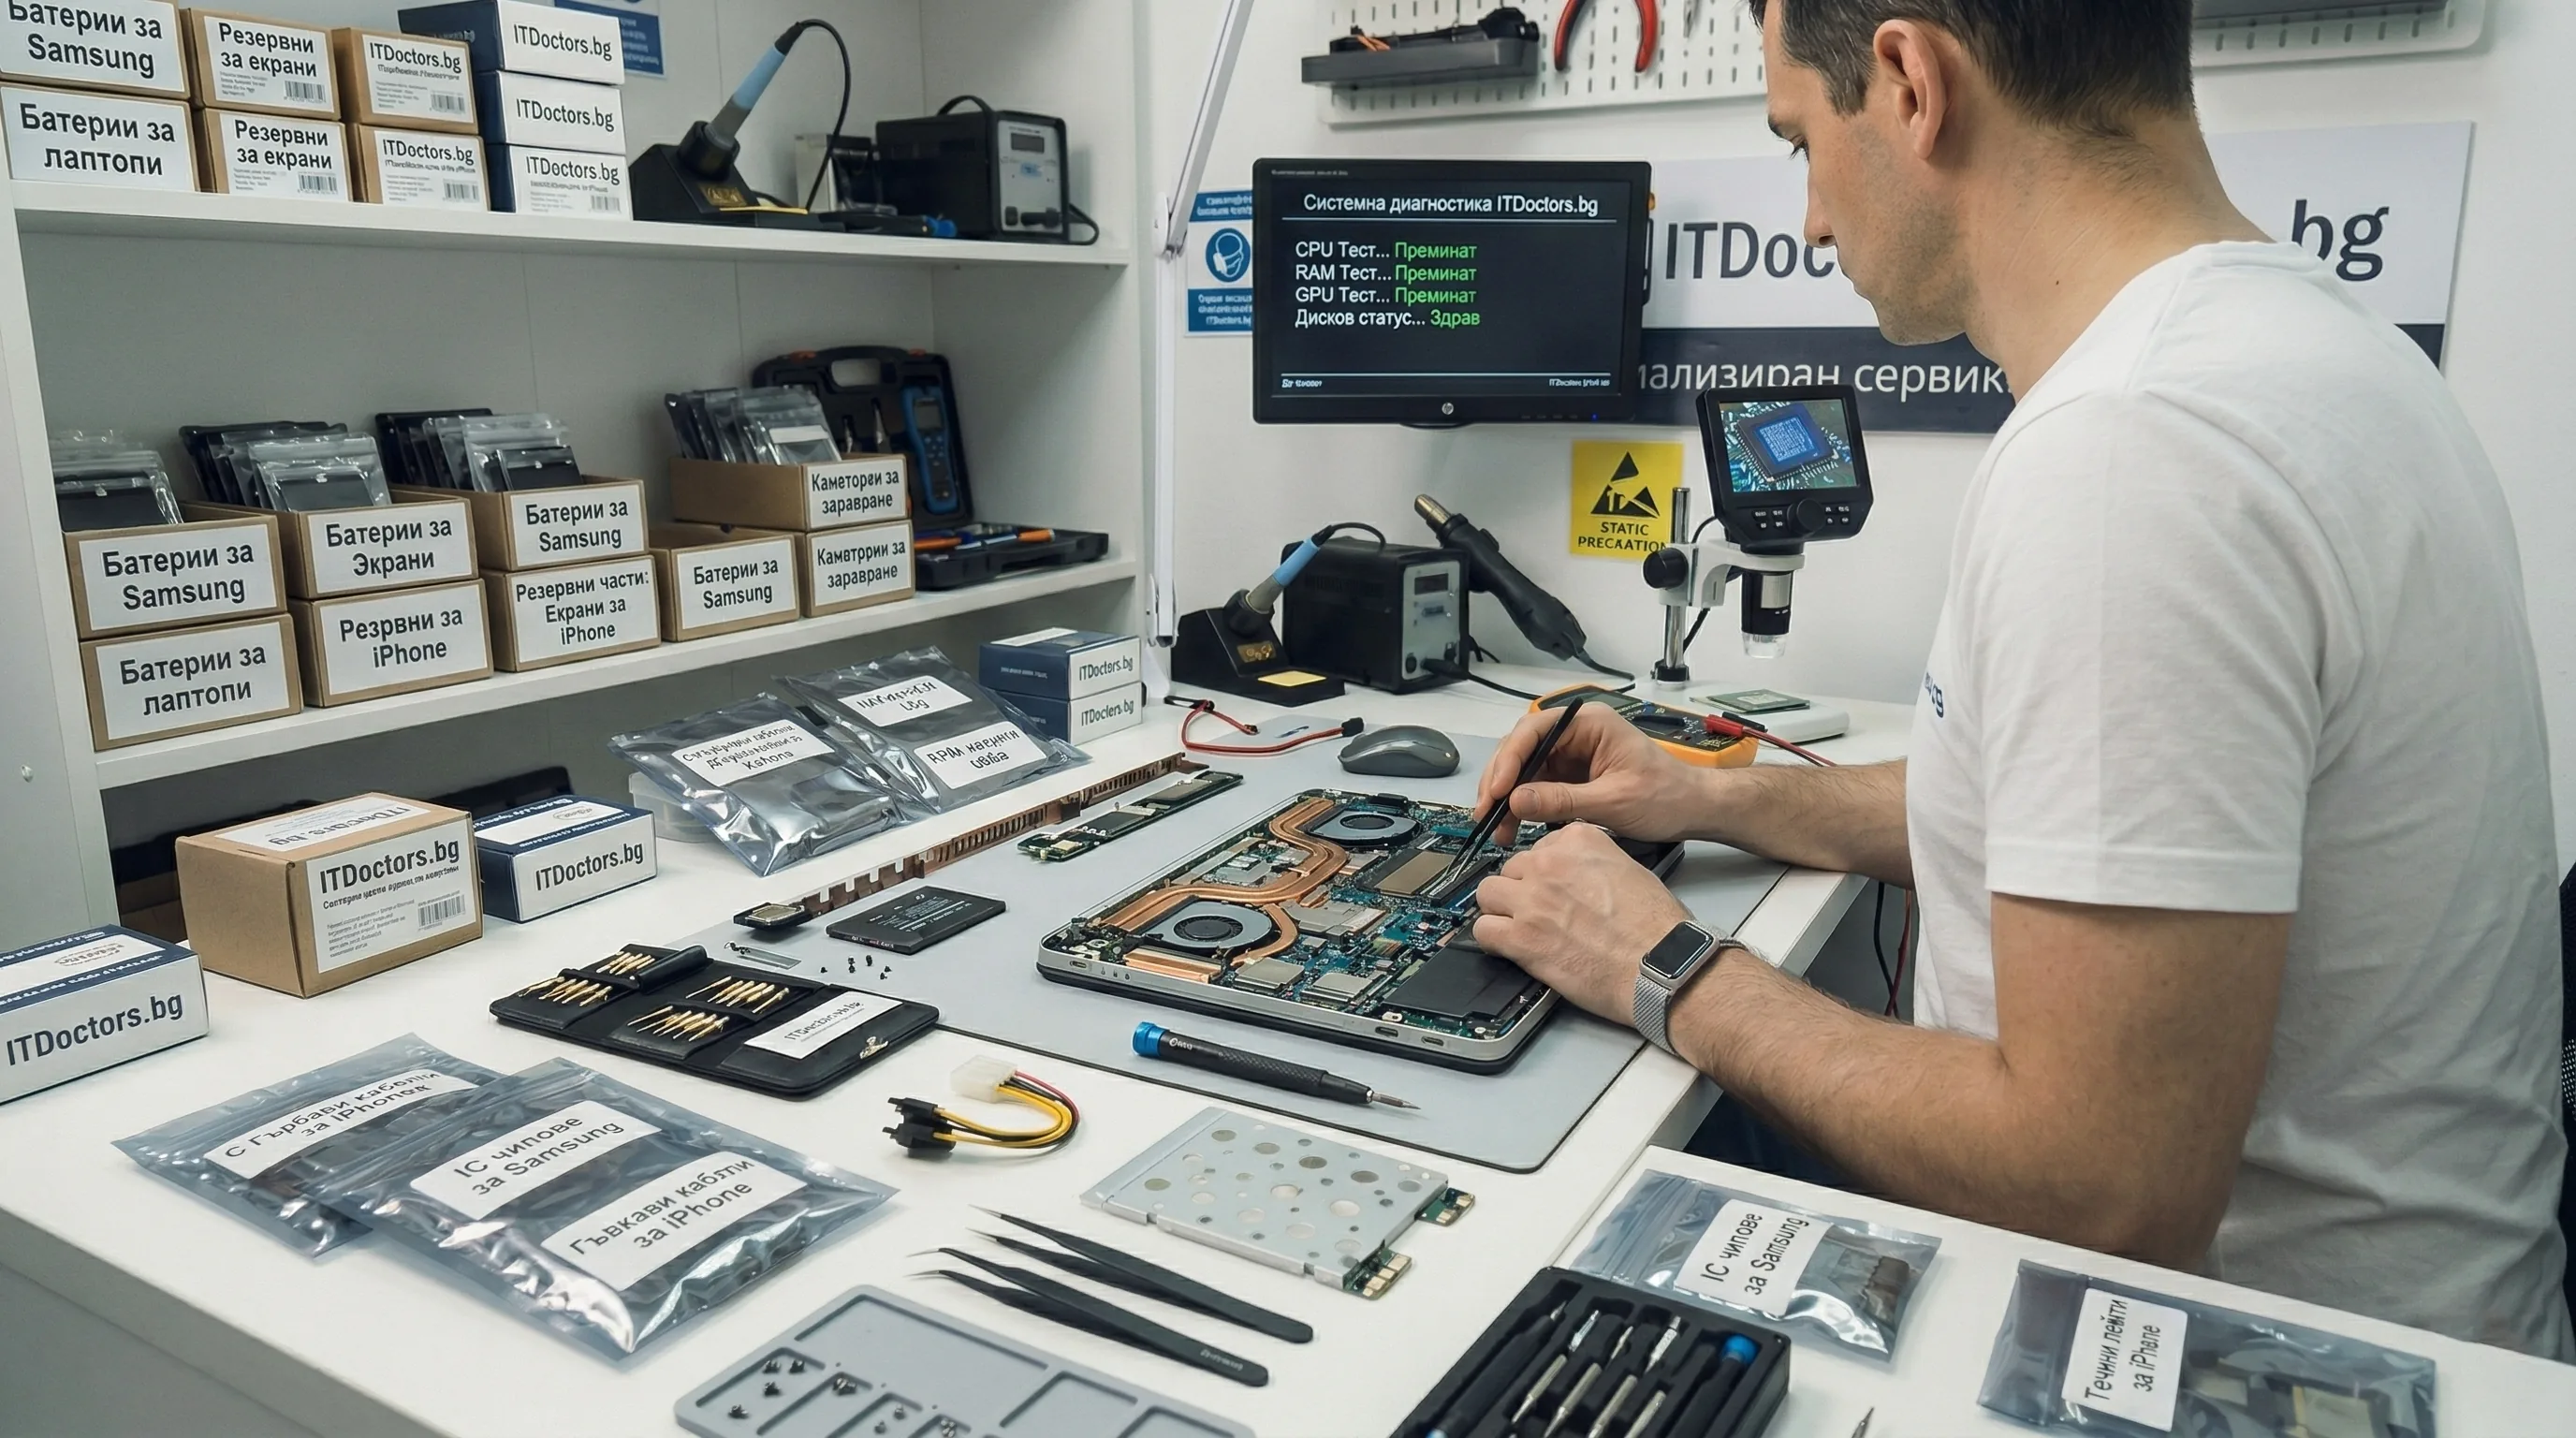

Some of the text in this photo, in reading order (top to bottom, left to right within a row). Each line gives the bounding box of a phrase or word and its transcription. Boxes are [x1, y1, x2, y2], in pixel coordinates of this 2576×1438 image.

[7, 0, 162, 39] Батерии за
[218, 22, 315, 53] Резервни
[513, 23, 613, 62] ITDoctors.bg
[27, 33, 154, 79] Samsung
[220, 51, 317, 77] за екрани
[370, 42, 461, 74] ITDoctors.bg
[20, 103, 175, 142] Батерии за
[516, 98, 615, 133] ITDoctors.bg
[235, 119, 329, 147] Резервни
[44, 147, 163, 176] лаптопи
[237, 147, 332, 170] за екрани
[382, 139, 475, 166] ITDoctors.bg
[525, 155, 621, 186] ITDoctors.bg
[1304, 193, 1599, 217] Системна диагностика ITDoctors.bg
[1295, 241, 1477, 262] CPU Тест... Преминат
[1295, 264, 1477, 285] RAM Тест... Преминат
[1295, 286, 1477, 307] GPU Тест... Преминат
[1295, 309, 1480, 330] Дисков статус... Здрав
[886, 470, 900, 484] за
[525, 501, 628, 526] Батерии за
[822, 493, 893, 517] заравране
[326, 519, 452, 548] Батерии за
[539, 528, 622, 552] Samsung
[1601, 521, 1649, 536] STATIC
[102, 544, 254, 578] Батерии за
[892, 541, 906, 554] за
[353, 551, 434, 579] Экрани
[694, 559, 779, 585] Батерии за
[827, 565, 898, 590] заравране
[123, 579, 244, 609] Samsung
[516, 570, 650, 602] Резервни части:
[703, 585, 772, 609] Samsung
[545, 598, 626, 624] Екрани за
[339, 609, 463, 642] Резрвни за
[561, 624, 616, 645] iPhone
[120, 646, 266, 684] Батерии за
[373, 640, 447, 668] iPhone
[143, 681, 252, 716] лаптопи
[320, 840, 460, 894] ITDoctors.bg
[535, 843, 644, 891] ITDoctors.bg
[7, 994, 183, 1066] ITDoctors.bg
[248, 1101, 350, 1145] Гърбави
[301, 1123, 330, 1137] за
[453, 1117, 583, 1178] IC чипове
[472, 1122, 625, 1196] за Samsung
[569, 1196, 677, 1255] Гъвкави
[633, 1181, 753, 1248] за iPhone
[1744, 1217, 1809, 1295] за Samsung
[1700, 1263, 1730, 1283] IC
[2133, 1373, 2154, 1392] за
